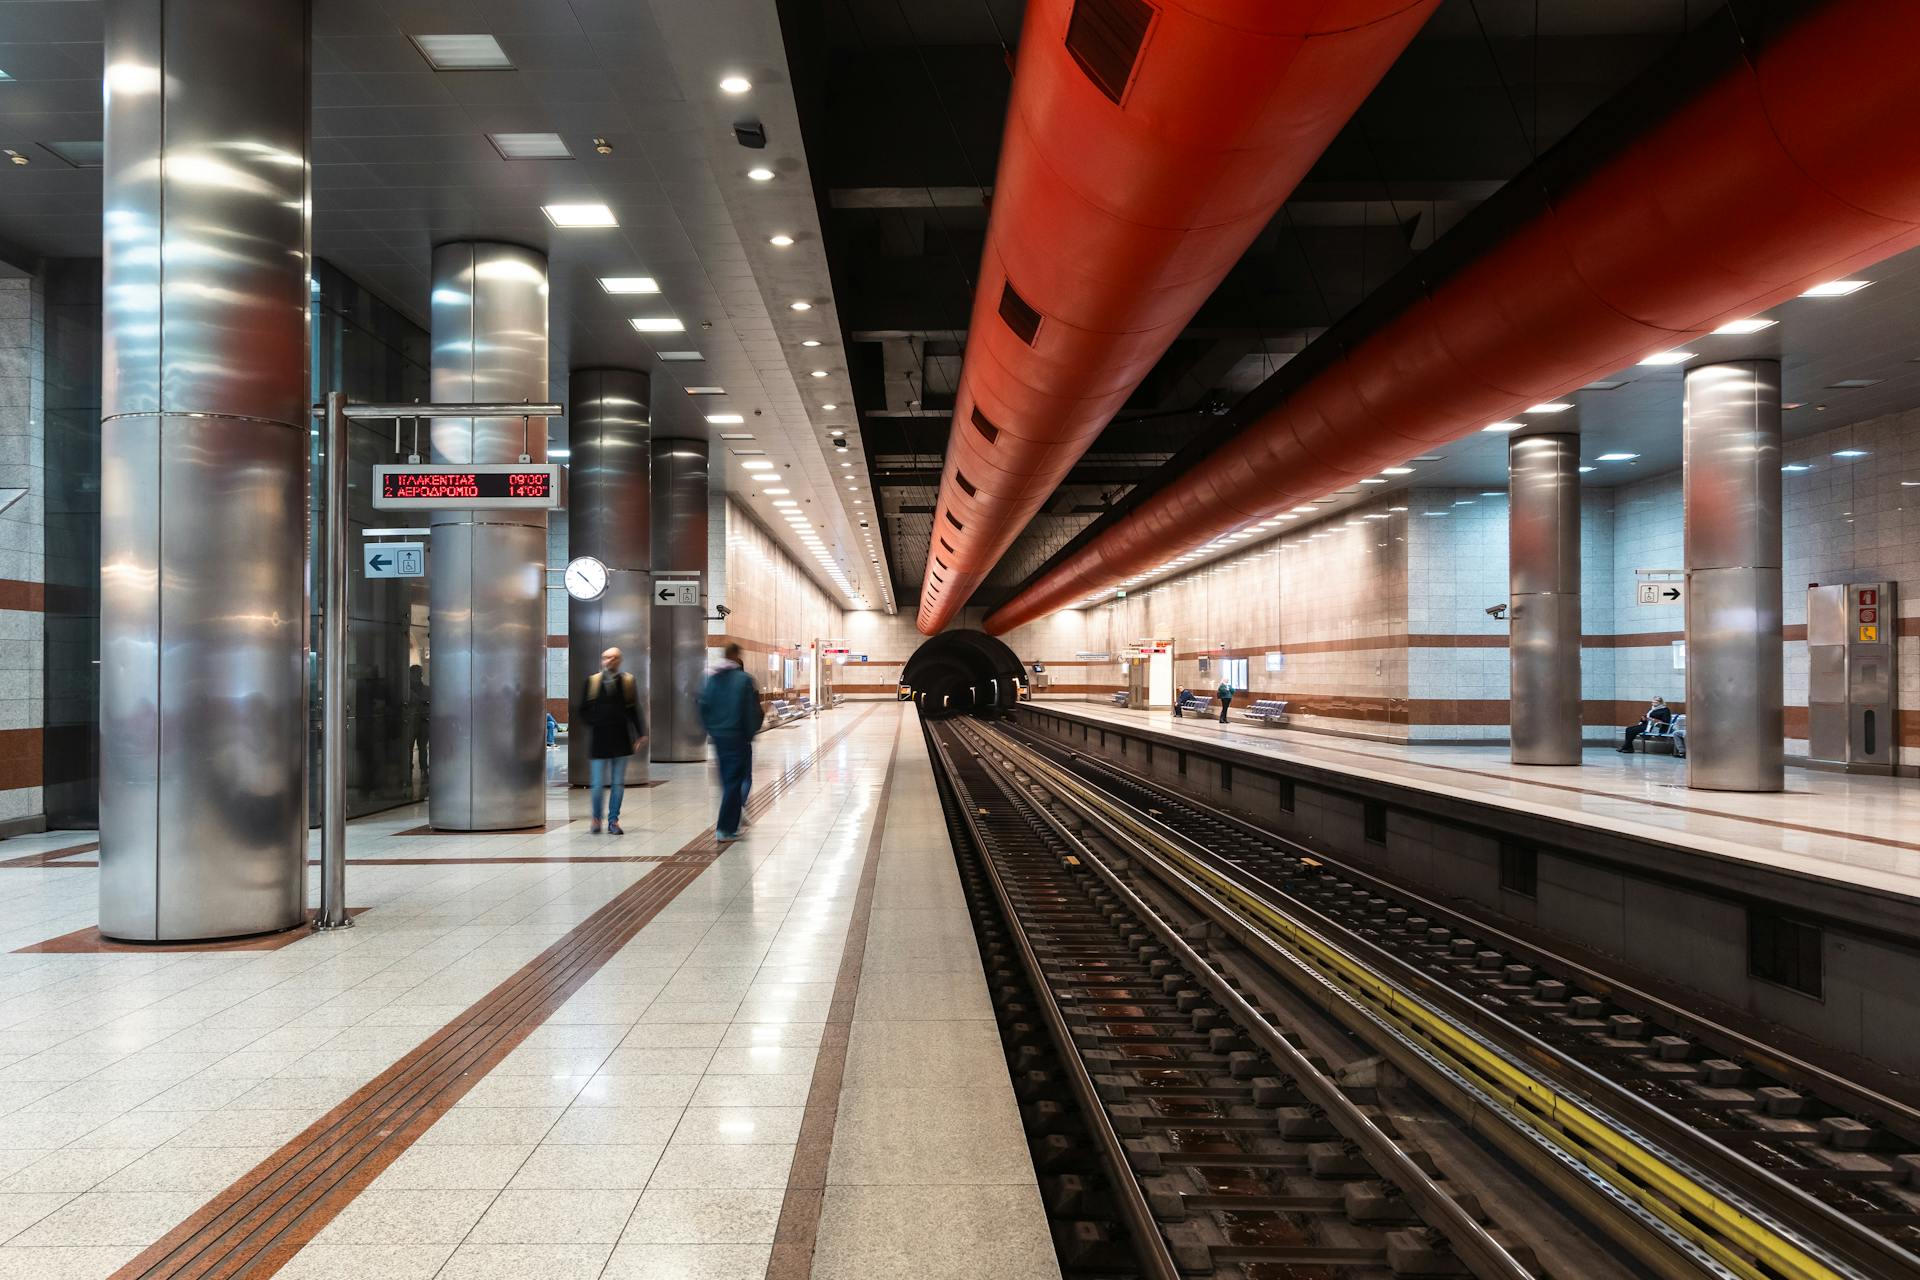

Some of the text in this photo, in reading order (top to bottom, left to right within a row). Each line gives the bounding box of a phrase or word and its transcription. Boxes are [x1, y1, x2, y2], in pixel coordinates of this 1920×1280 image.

[397, 475, 476, 485] ΠΛΑΚΕΝΤΙΑΣ
[384, 486, 393, 497] 2
[397, 486, 478, 497] ΑΕΡΟΔΡΟΜΙΟ
